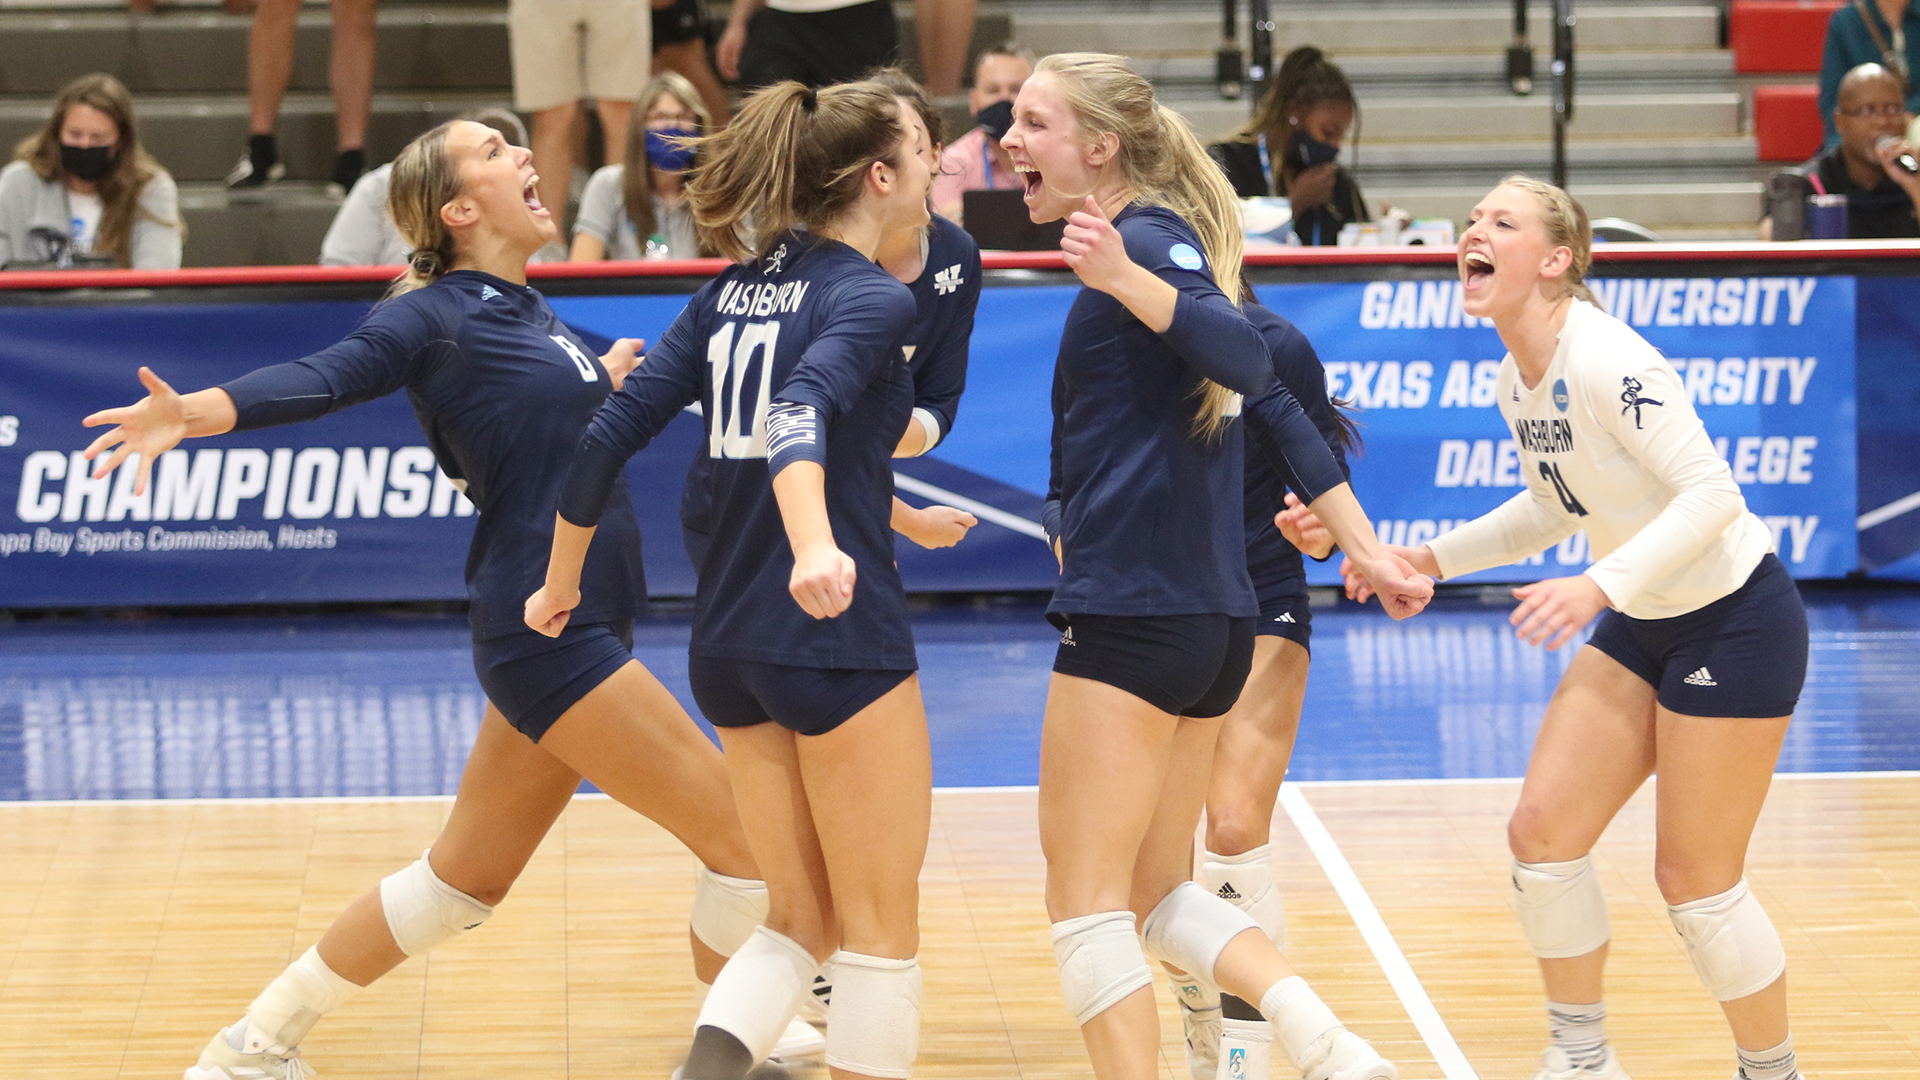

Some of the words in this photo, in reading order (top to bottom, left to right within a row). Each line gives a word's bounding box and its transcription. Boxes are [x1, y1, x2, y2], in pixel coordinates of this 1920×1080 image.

[1359, 280, 1497, 329] GANN
[1583, 278, 1817, 326] NIVERSITY
[707, 320, 780, 459] 10
[1325, 361, 1434, 409] EXAS
[1440, 360, 1500, 408] A&
[1667, 356, 1818, 406] RSITY
[17, 447, 480, 522] CHAMPIONSH
[1435, 440, 1526, 487] DAE
[33, 527, 74, 557] Bay
[75, 526, 145, 557] Sports
[146, 525, 274, 551] Commission,
[277, 524, 338, 549] Hosts
